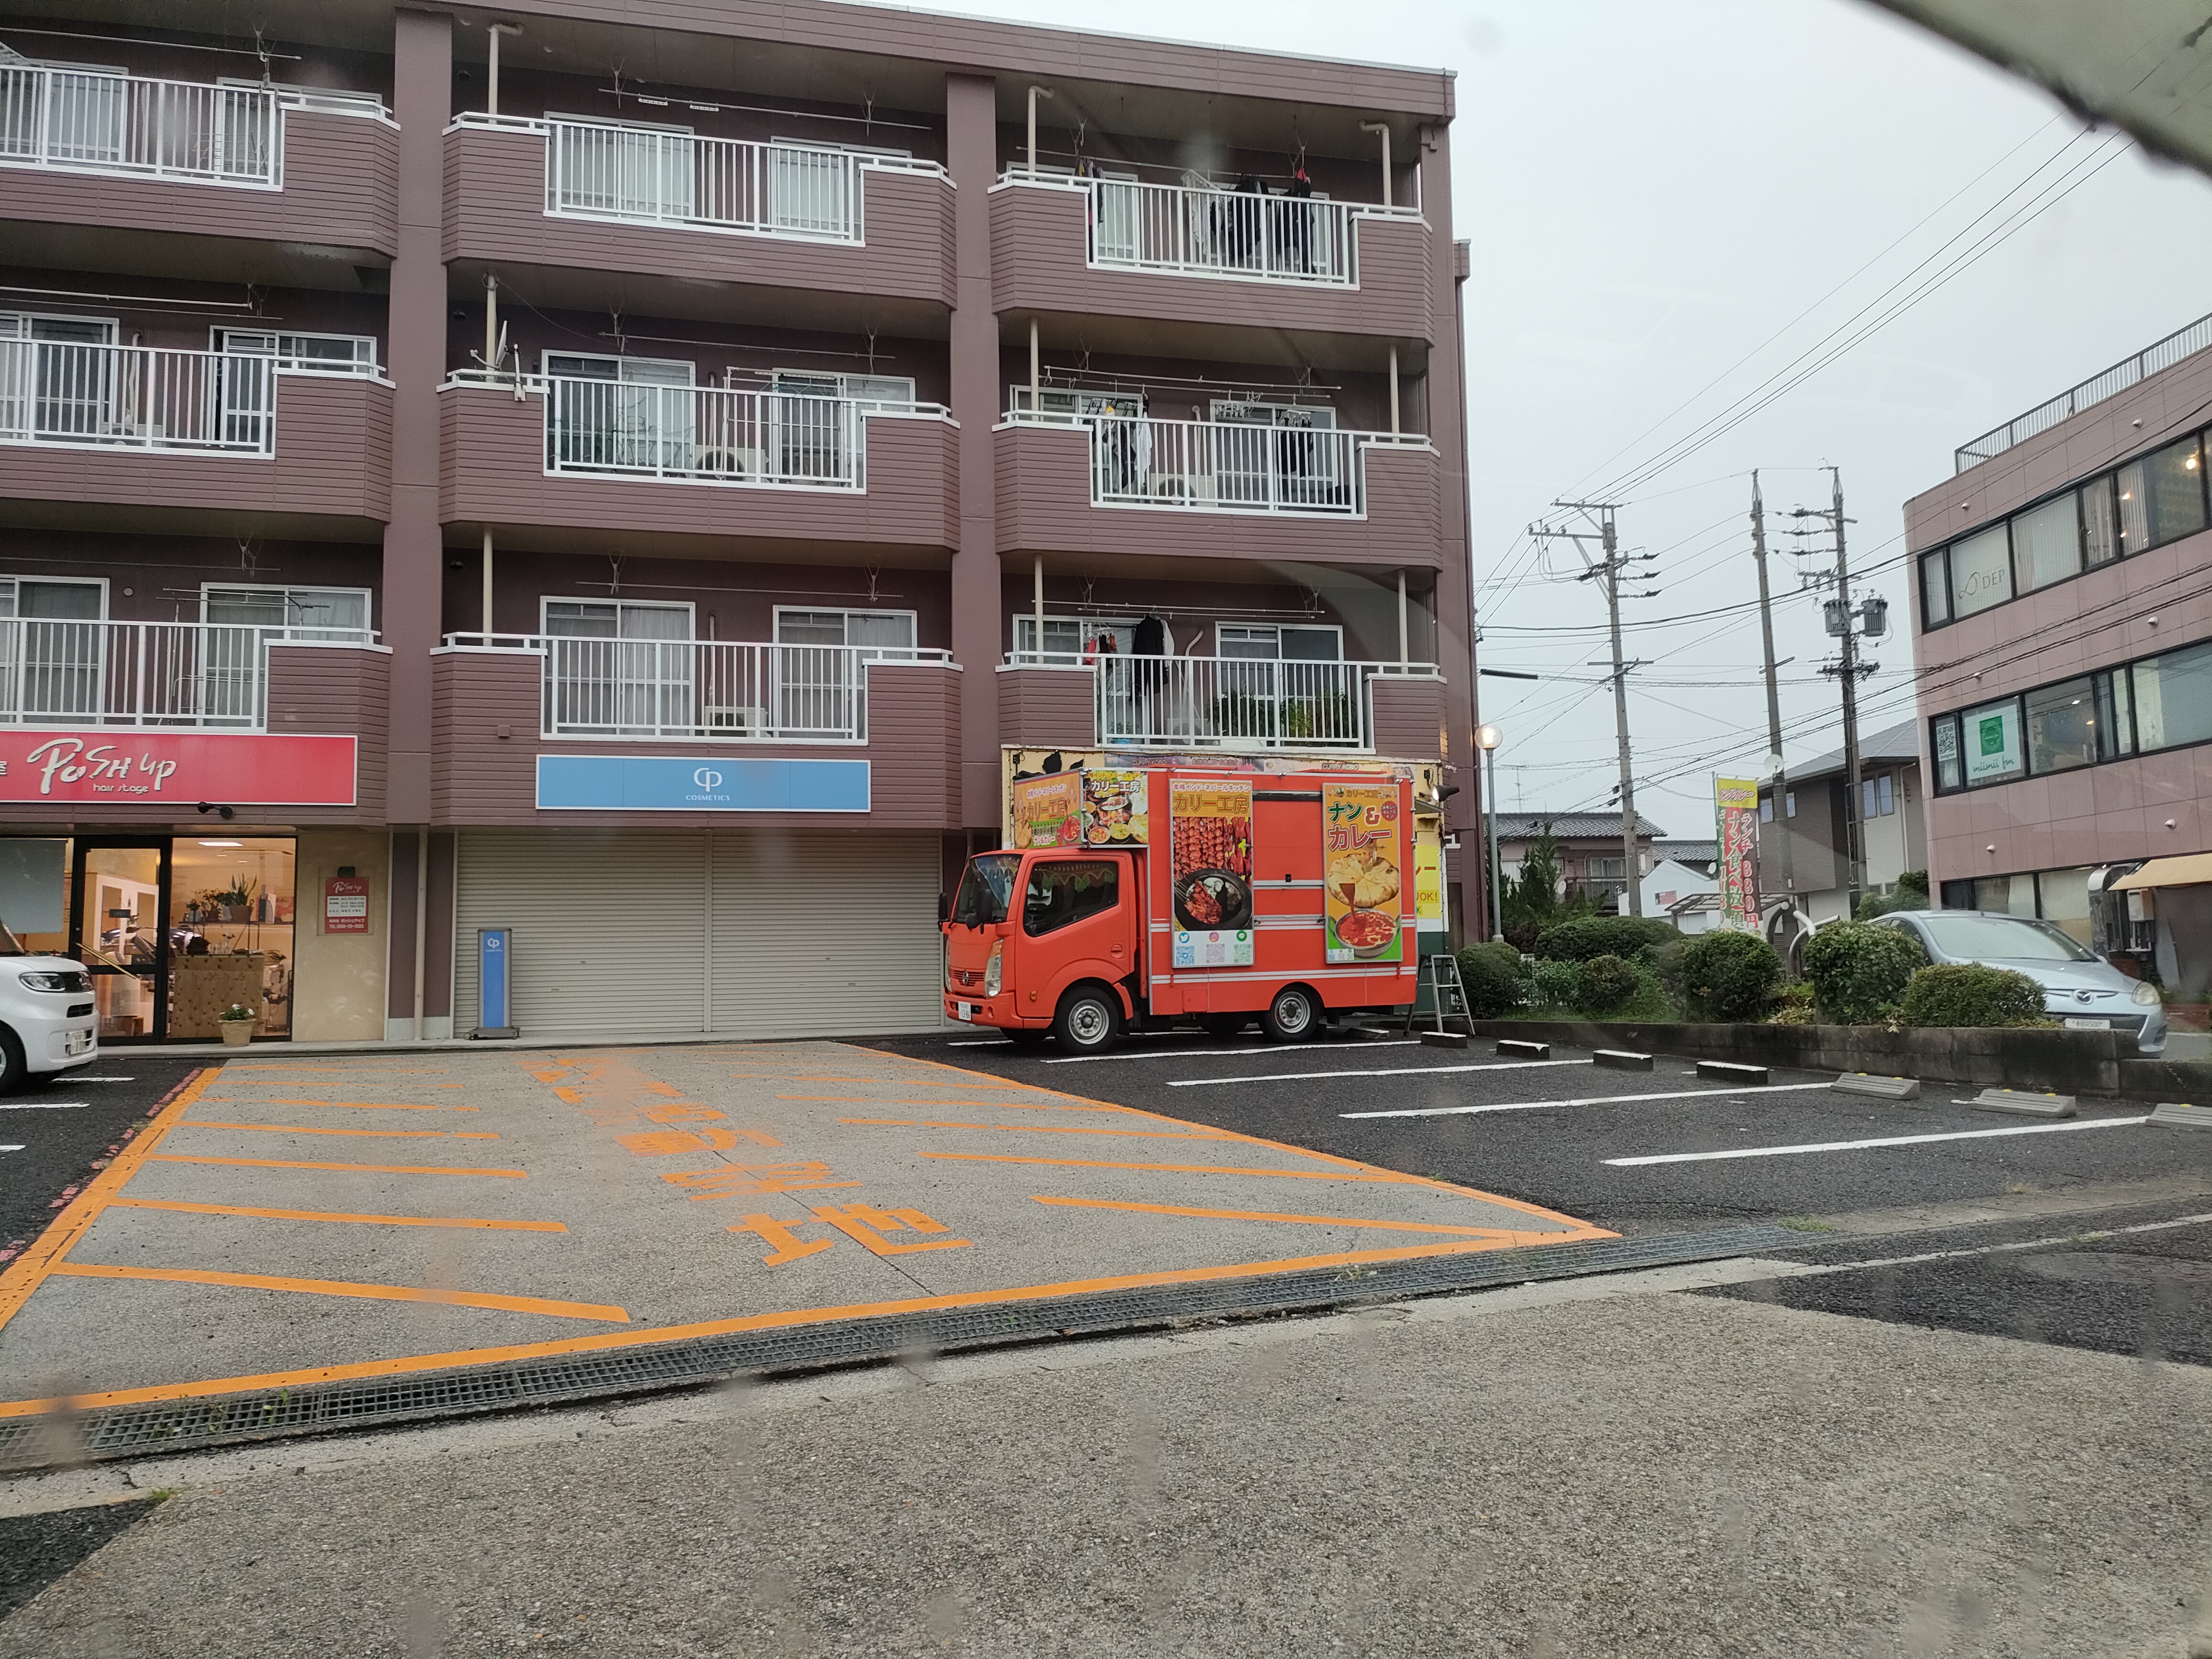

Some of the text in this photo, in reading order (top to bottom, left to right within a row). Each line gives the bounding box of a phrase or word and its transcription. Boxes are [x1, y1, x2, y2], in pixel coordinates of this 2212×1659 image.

[1982, 569, 2005, 589] DEP
[93, 783, 149, 794] hair stage
[1091, 780, 1141, 793] カリー工房
[1346, 789, 1379, 798] カリー工房
[685, 794, 730, 802] COSMETICS
[1173, 794, 1250, 814] カリー工房
[1027, 796, 1068, 822] カリー工房
[1328, 801, 1381, 827] ナン &
[1328, 824, 1393, 852] カレー
[1741, 813, 1754, 856] ランチ
